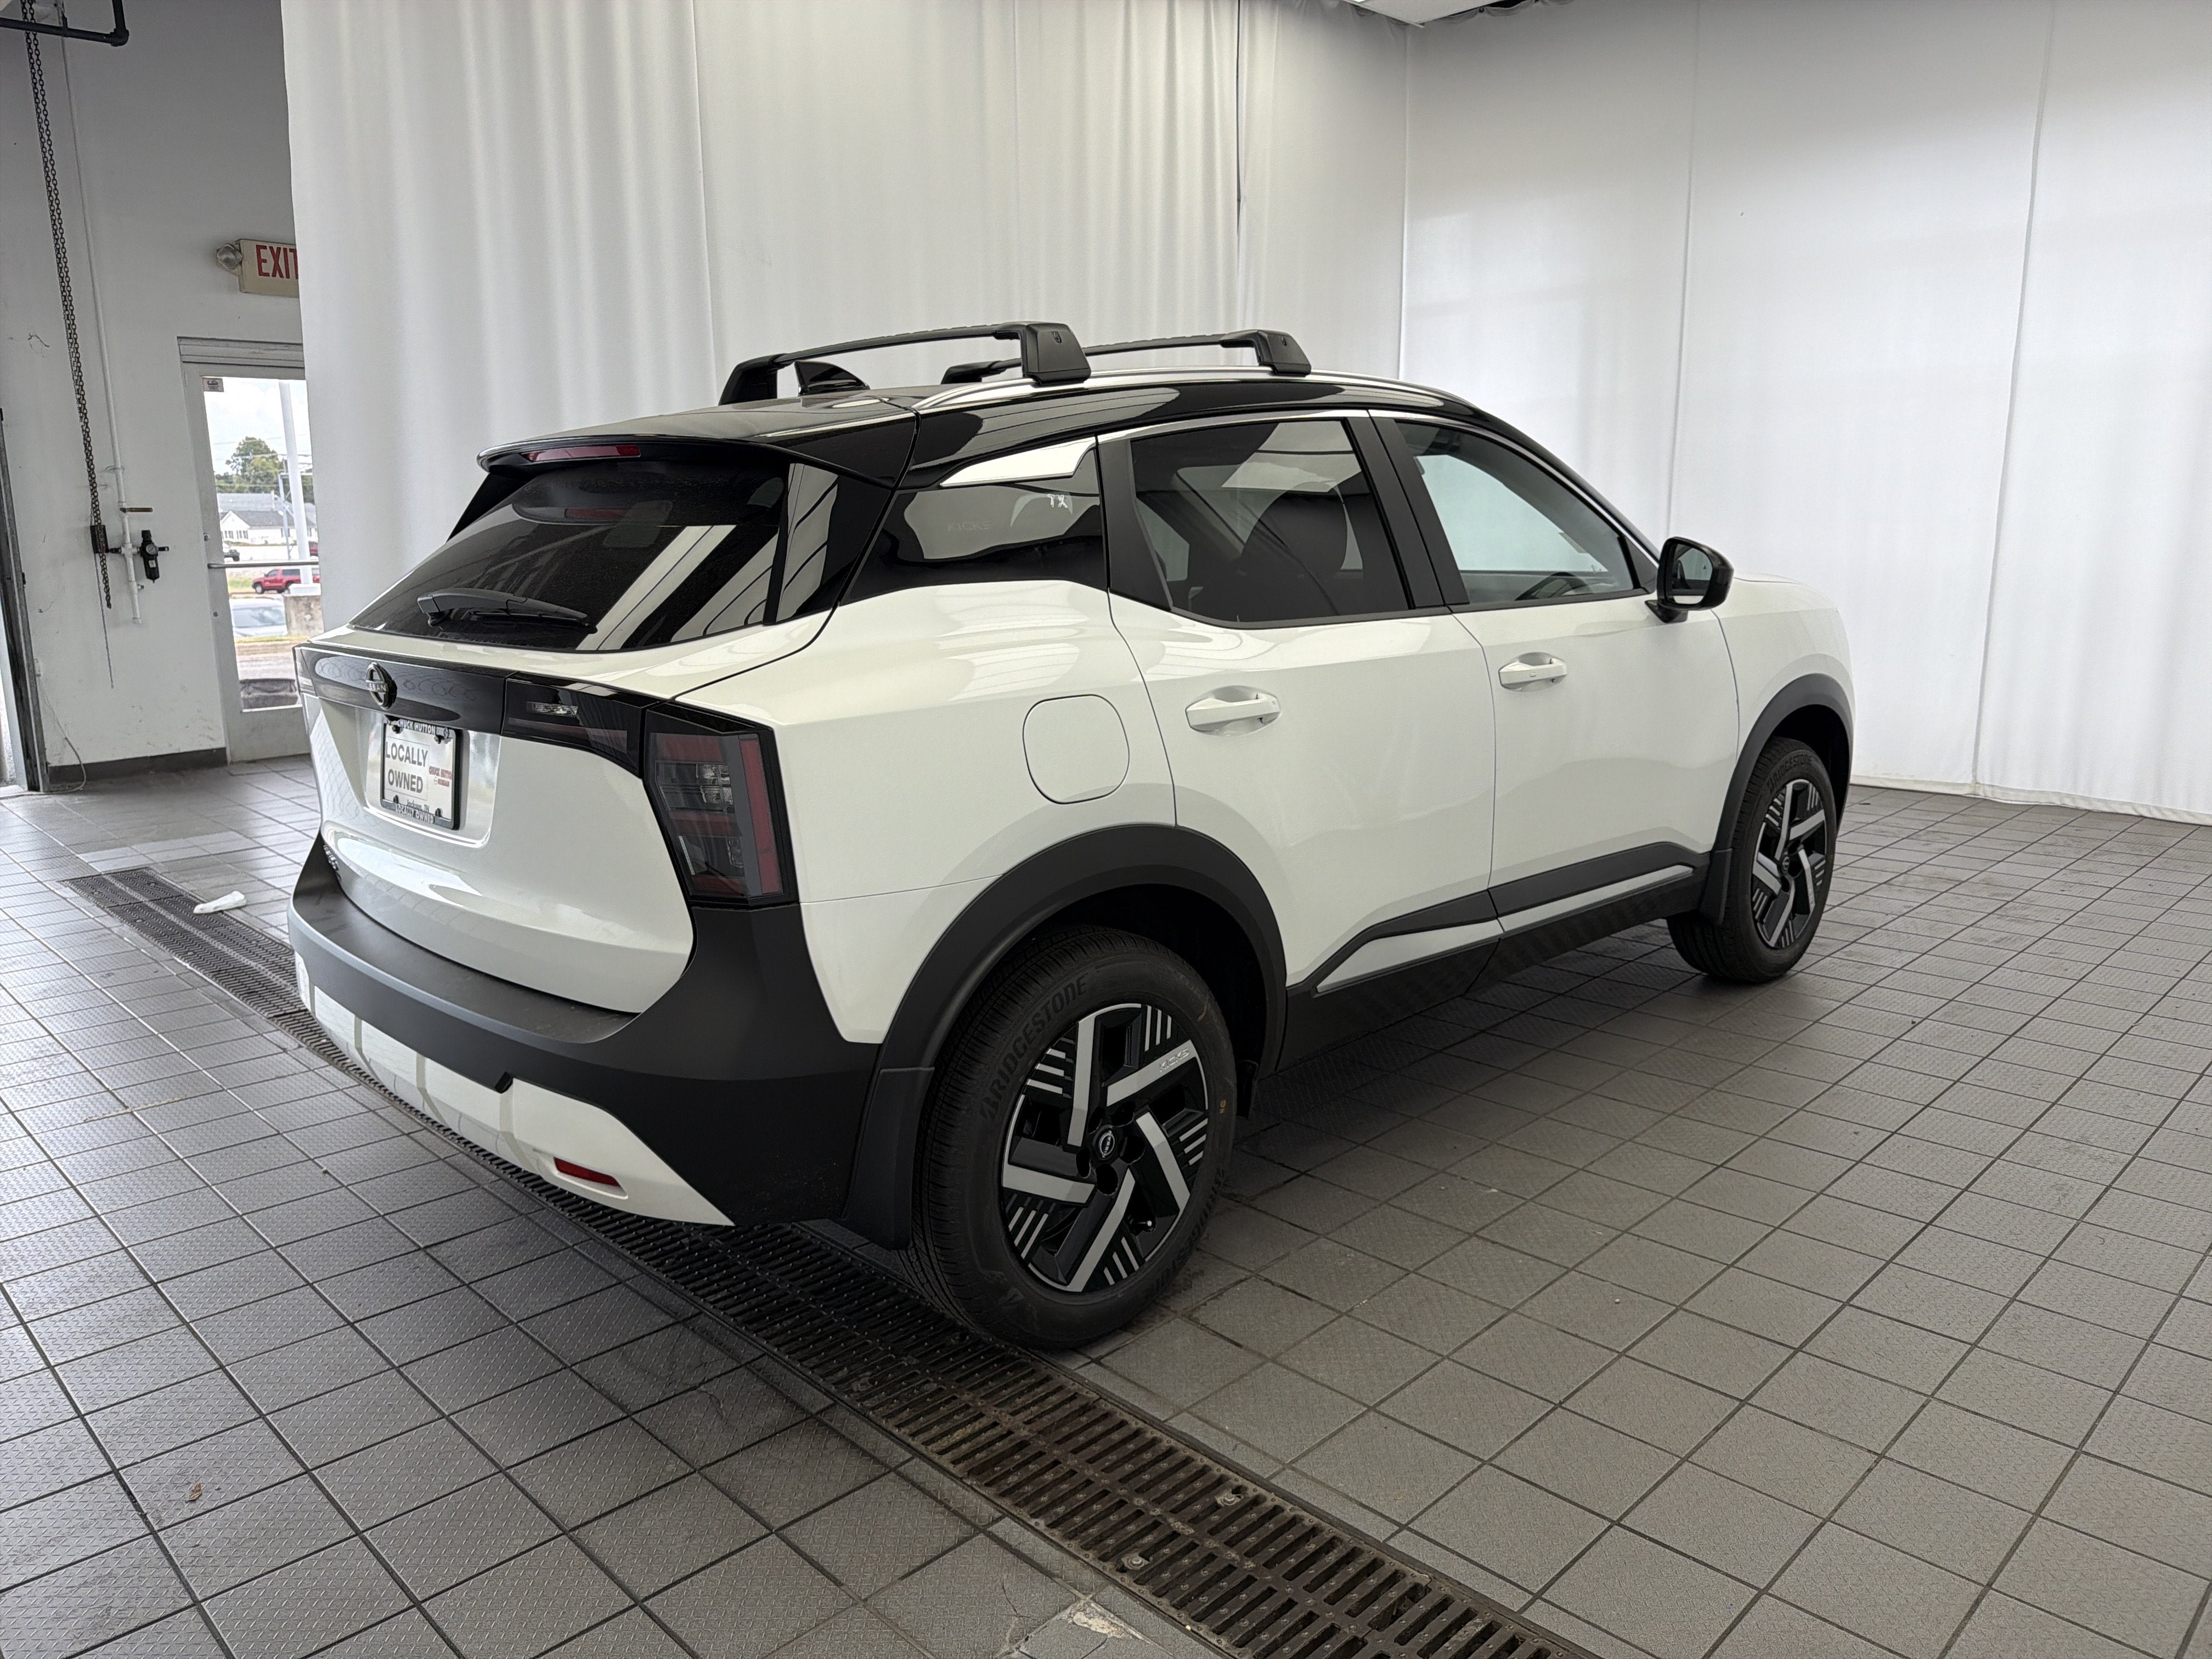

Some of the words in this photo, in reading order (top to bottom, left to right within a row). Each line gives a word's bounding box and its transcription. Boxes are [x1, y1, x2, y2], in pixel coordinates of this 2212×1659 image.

[256, 244, 298, 280] EXIT
[415, 721, 436, 736] HUTTON
[386, 741, 428, 768] LOCALLY
[388, 769, 424, 793] OWNED
[396, 803, 415, 817] LOCALLY
[415, 809, 434, 824] OWNED
[979, 972, 1089, 1122] BRIDGESTONE
[1159, 1048, 1189, 1073] KICKS
